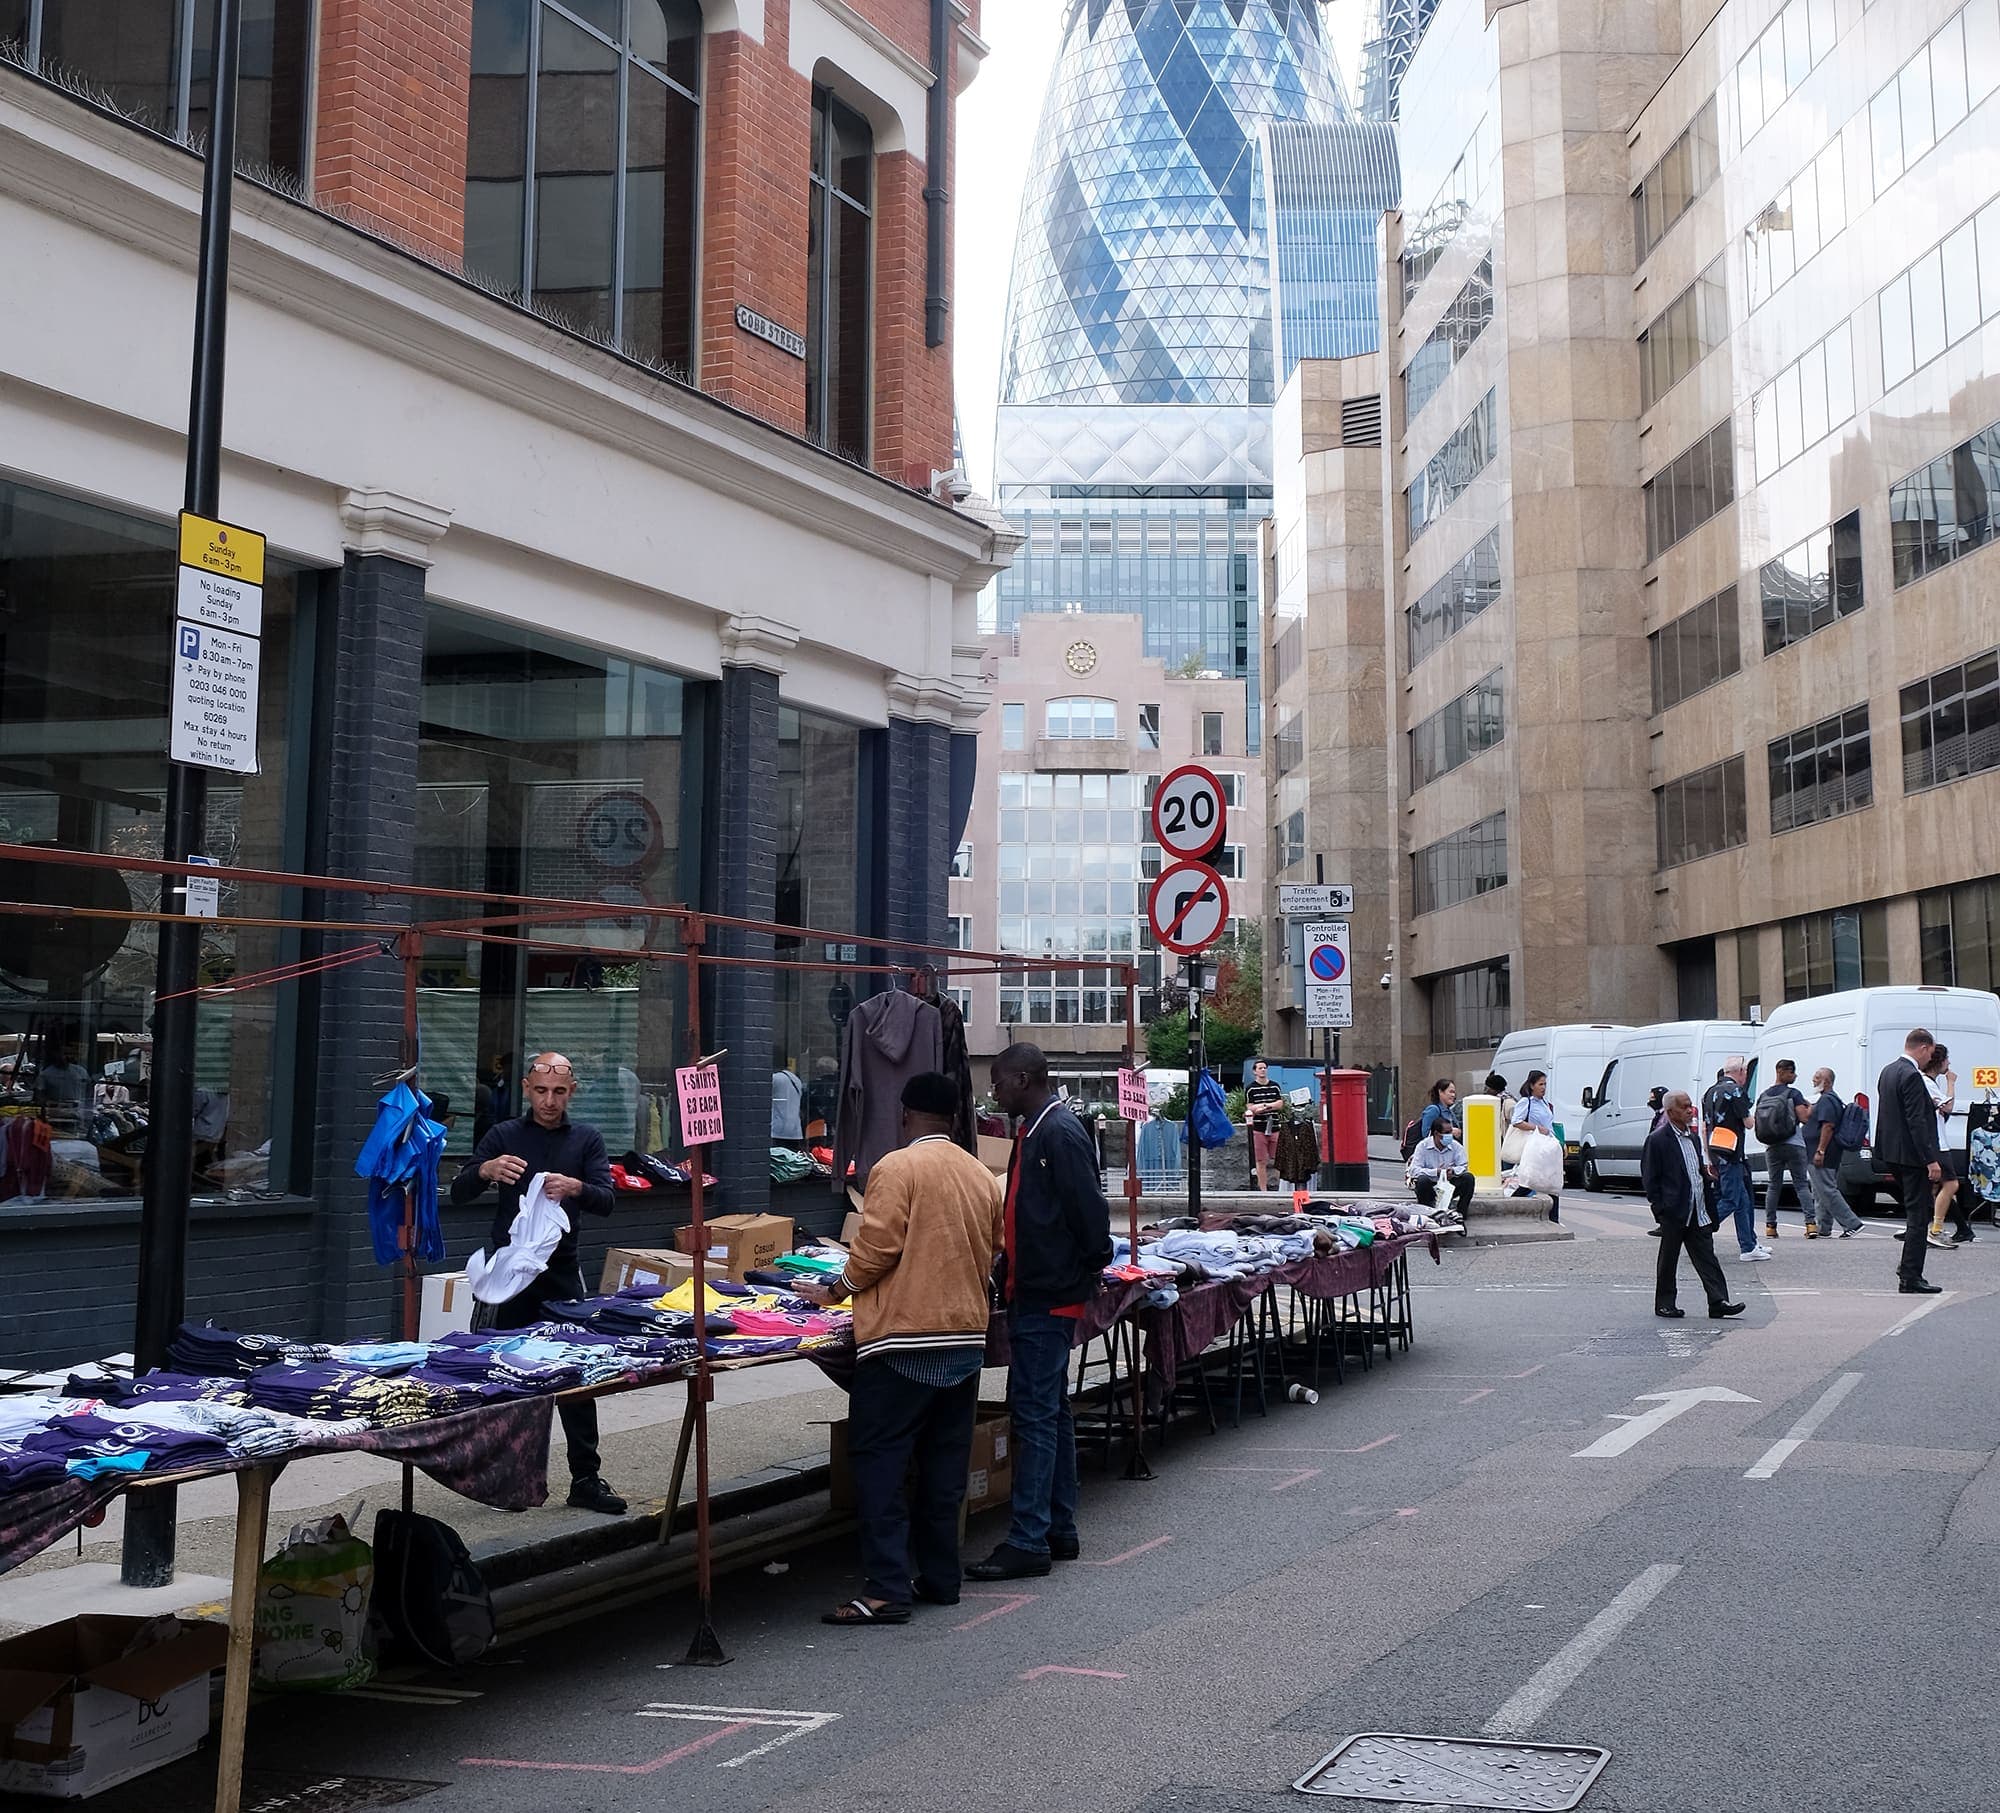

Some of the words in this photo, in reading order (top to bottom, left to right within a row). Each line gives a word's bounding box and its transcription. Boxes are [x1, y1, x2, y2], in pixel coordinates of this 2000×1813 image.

[741, 310, 766, 335] COBB
[768, 325, 803, 354] STREET
[208, 542, 236, 559] Sunday
[200, 579, 211, 591] No
[213, 582, 241, 601] loading
[206, 594, 233, 611] Sunday
[198, 665, 211, 678] Pay
[213, 669, 223, 680] by
[224, 673, 246, 685] phone
[189, 679, 210, 692] 0203
[212, 683, 227, 696] 046
[229, 688, 247, 700] 0010
[187, 693, 215, 709] quoting
[216, 699, 246, 713] location
[204, 711, 228, 725] 60269
[184, 720, 199, 732] Max
[202, 725, 218, 738] stay
[220, 729, 225, 737] 4
[227, 729, 247, 742] hours
[197, 736, 208, 747] No
[210, 740, 232, 751] return
[190, 750, 212, 762] within
[214, 754, 218, 763] 1
[220, 754, 235, 766] hour
[1164, 791, 1215, 835] 20
[1305, 924, 1347, 932] Controlled
[1314, 934, 1338, 942] ZONE
[682, 1072, 717, 1090] T-SHIRTS
[1976, 1070, 1997, 1085] £3
[687, 1098, 698, 1114] £3
[700, 1096, 719, 1113] EACH
[688, 1121, 693, 1138] 4
[694, 1120, 708, 1137] FOR
[708, 1118, 721, 1135] £10
[754, 1240, 776, 1255] Casual
